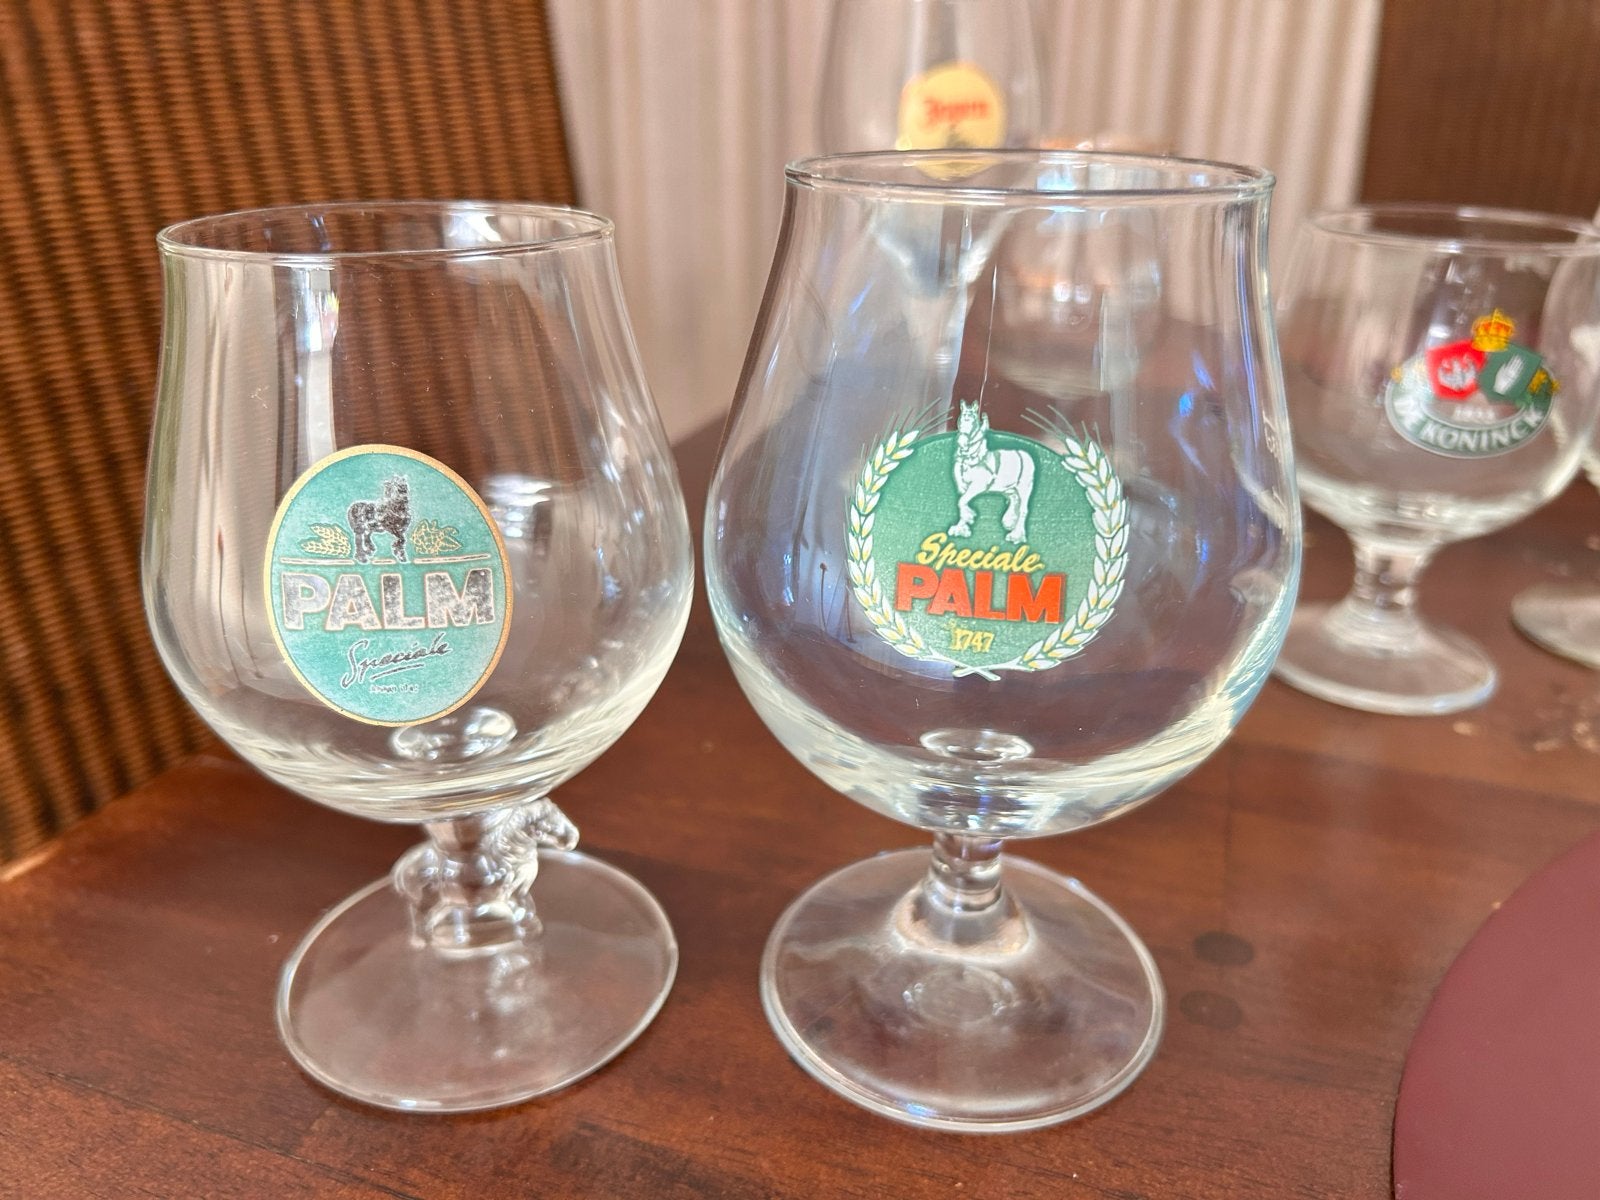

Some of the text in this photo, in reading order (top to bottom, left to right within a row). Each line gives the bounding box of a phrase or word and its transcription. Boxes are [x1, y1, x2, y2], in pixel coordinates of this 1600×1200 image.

[1419, 402, 1543, 451] KONINCK
[916, 533, 1045, 573] Speciale
[280, 567, 496, 632] PALM
[894, 562, 1067, 624] PALM
[340, 633, 452, 688] Speciale
[950, 627, 995, 653] 1747
